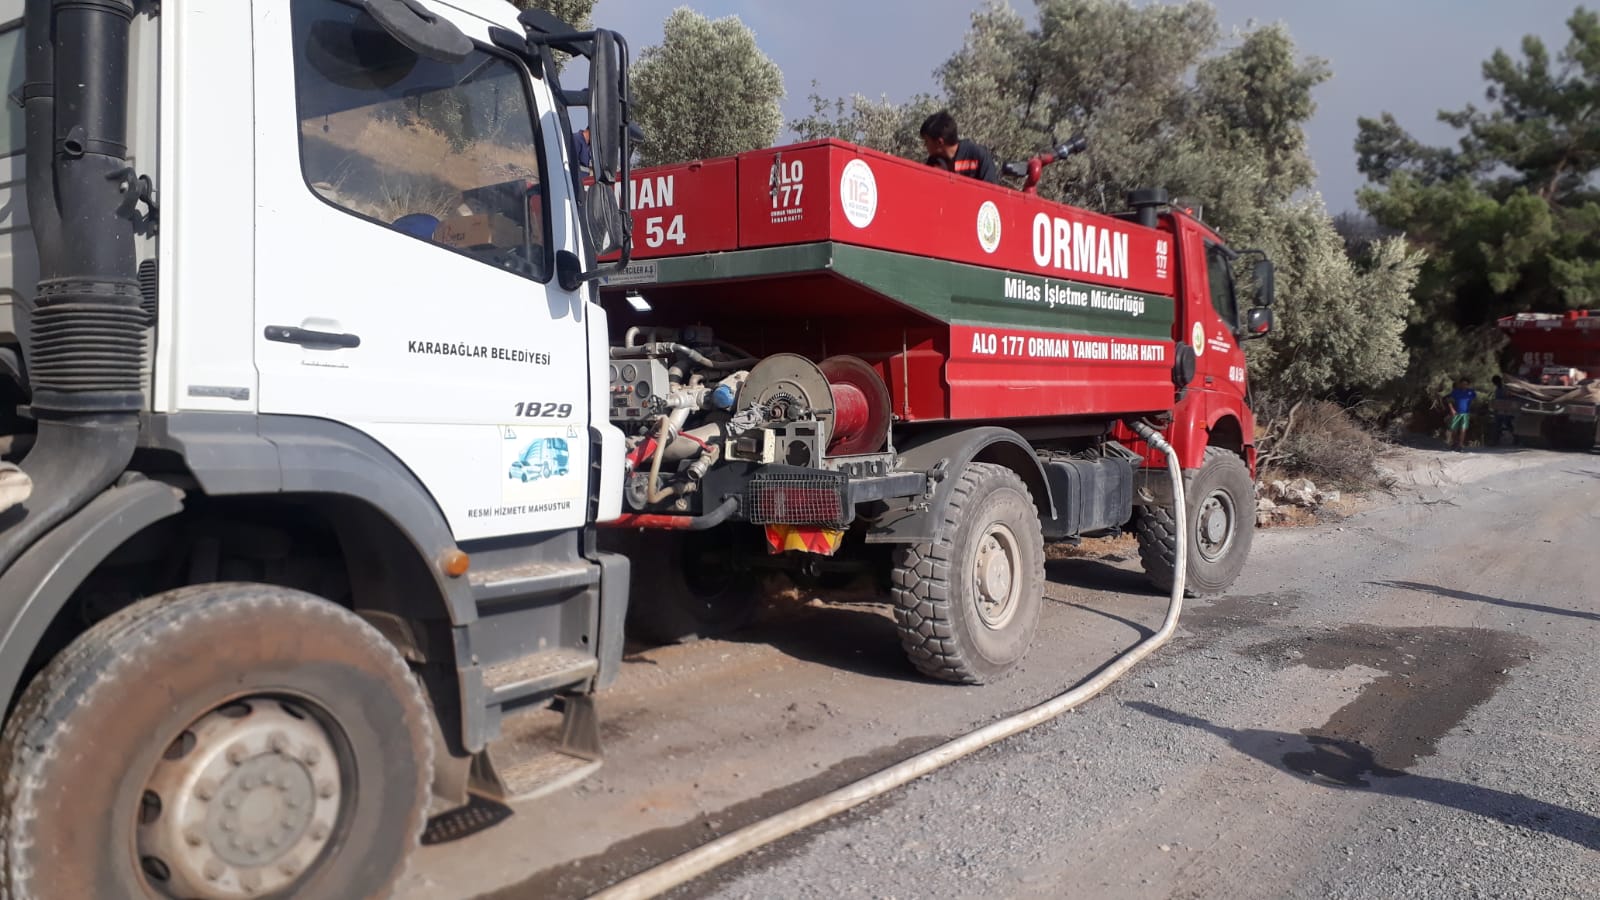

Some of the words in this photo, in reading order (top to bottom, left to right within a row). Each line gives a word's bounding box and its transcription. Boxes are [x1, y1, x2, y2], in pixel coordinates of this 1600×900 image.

[769, 184, 803, 208] 177
[646, 214, 686, 248] 54
[1033, 212, 1129, 279] ORMAN
[1004, 277, 1040, 302] Milas
[1044, 279, 1088, 308] İşletme
[1091, 290, 1145, 317] Müdürlüğü
[408, 340, 487, 358] KARABAĞLAR
[491, 347, 551, 365] BELEDİYESİ
[972, 332, 997, 354] ALO
[1001, 336, 1025, 356] 177
[1028, 337, 1069, 358] ORMAN
[1072, 340, 1109, 360] YANGIN
[1111, 338, 1139, 361] İHBAR
[1140, 344, 1164, 361] HATTI
[514, 402, 572, 418] 1829
[468, 506, 492, 518] RESMİ
[494, 505, 526, 516] HİZMETE
[528, 501, 571, 513] MAHSUSTUR
